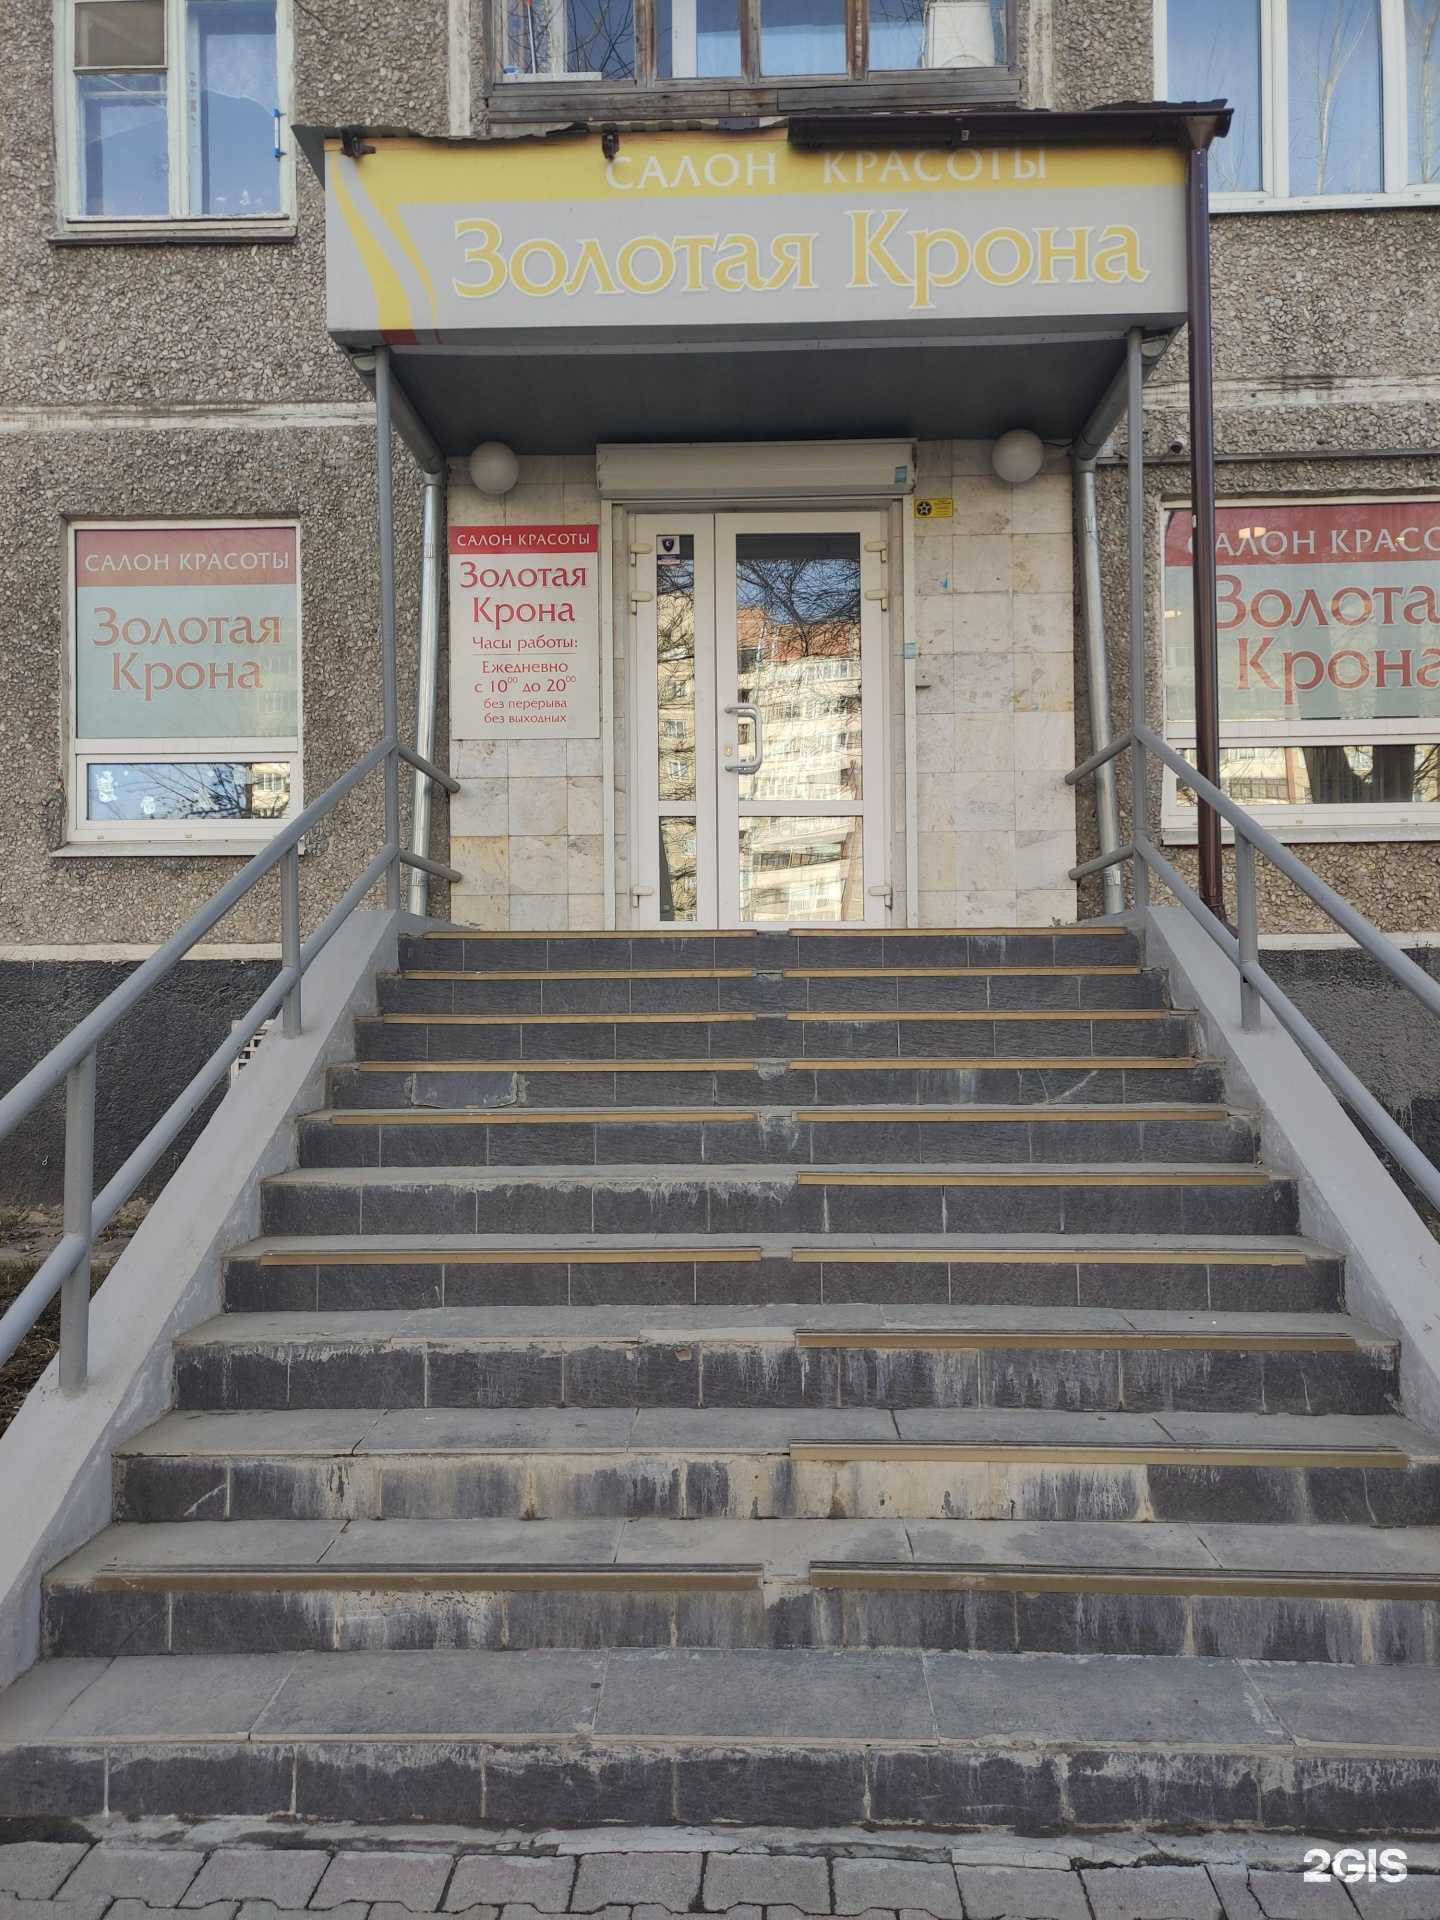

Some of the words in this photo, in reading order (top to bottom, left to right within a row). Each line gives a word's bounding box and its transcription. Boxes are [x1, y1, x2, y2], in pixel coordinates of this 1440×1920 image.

[606, 151, 776, 190] САЛОН
[823, 147, 1047, 184] КРАСОТЫ
[452, 217, 819, 299] Золотая
[845, 207, 1151, 311] Крона
[457, 534, 512, 546] САЛОН
[518, 533, 590, 545] КРАСОТЫ
[1187, 529, 1316, 556] АЛОН
[84, 553, 170, 572] САЛОН
[179, 551, 290, 571] КРАСОТЫ
[460, 561, 587, 588] Золотая
[473, 597, 576, 630] Крона
[92, 605, 283, 647] Золотая
[472, 636, 512, 649] Часы
[517, 634, 578, 652] работы:
[111, 652, 265, 702] Крона
[482, 660, 569, 673] Ежедневно
[522, 682, 541, 693] до
[483, 698, 505, 709] без
[508, 699, 568, 710] перерыва
[484, 713, 505, 723] без
[509, 714, 567, 723] выходных
